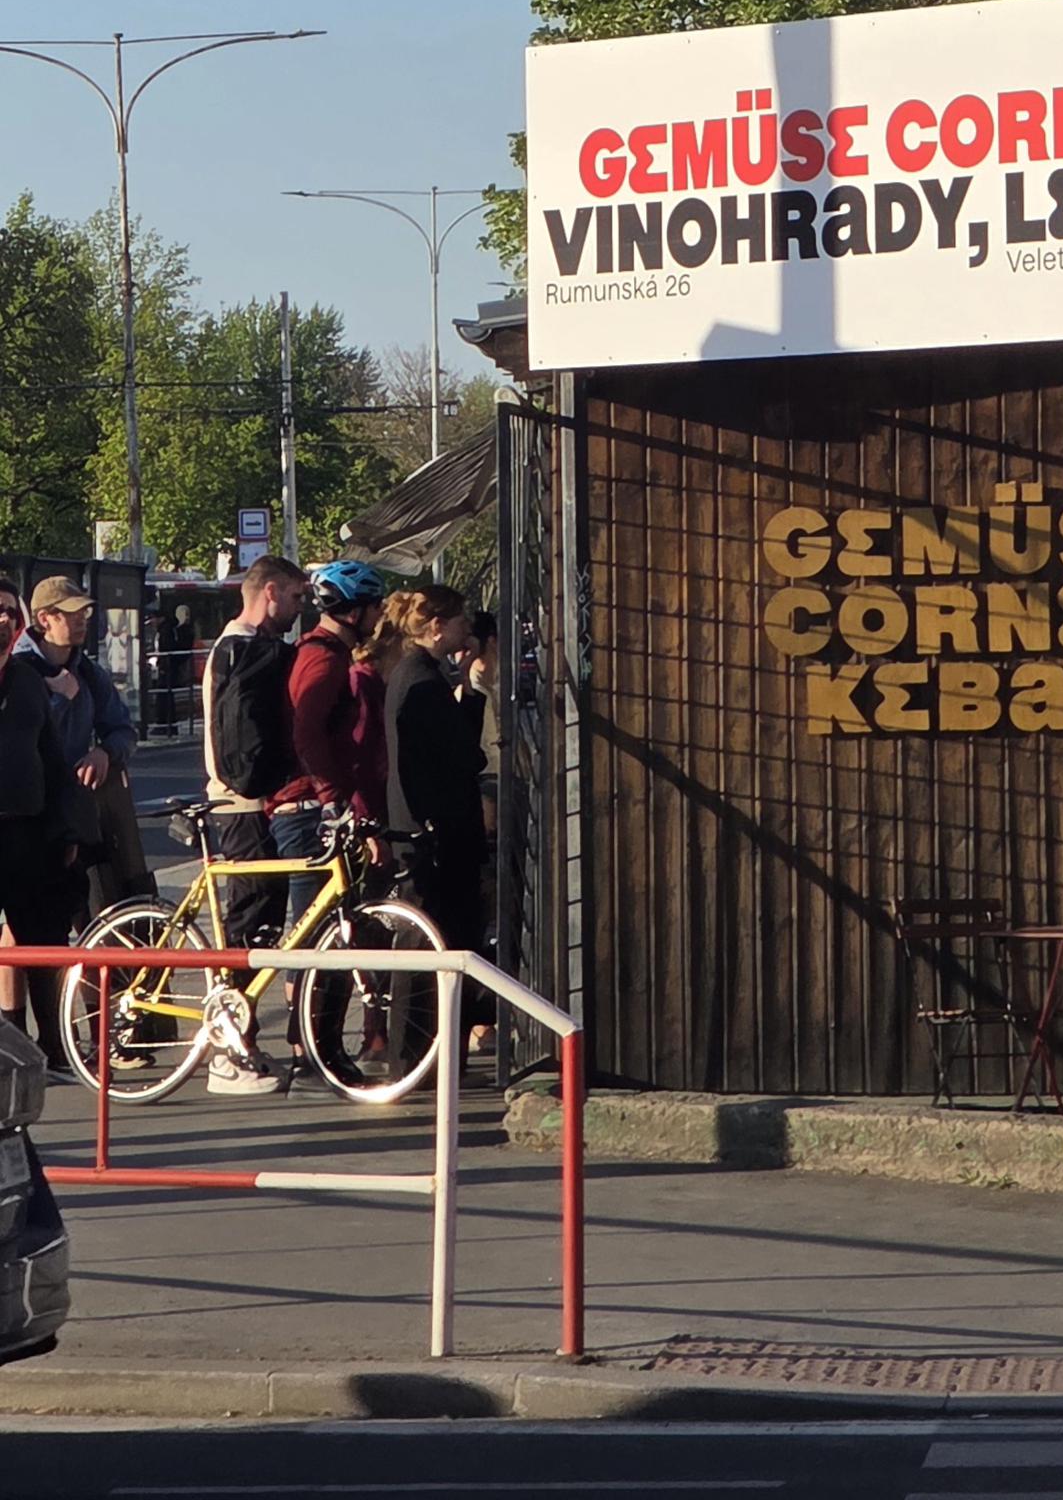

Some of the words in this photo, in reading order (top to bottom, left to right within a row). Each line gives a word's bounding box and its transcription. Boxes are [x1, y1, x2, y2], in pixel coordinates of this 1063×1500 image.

[578, 88, 869, 198] GEMÜSE
[545, 274, 658, 305] Rumunská
[665, 274, 691, 297] 26
